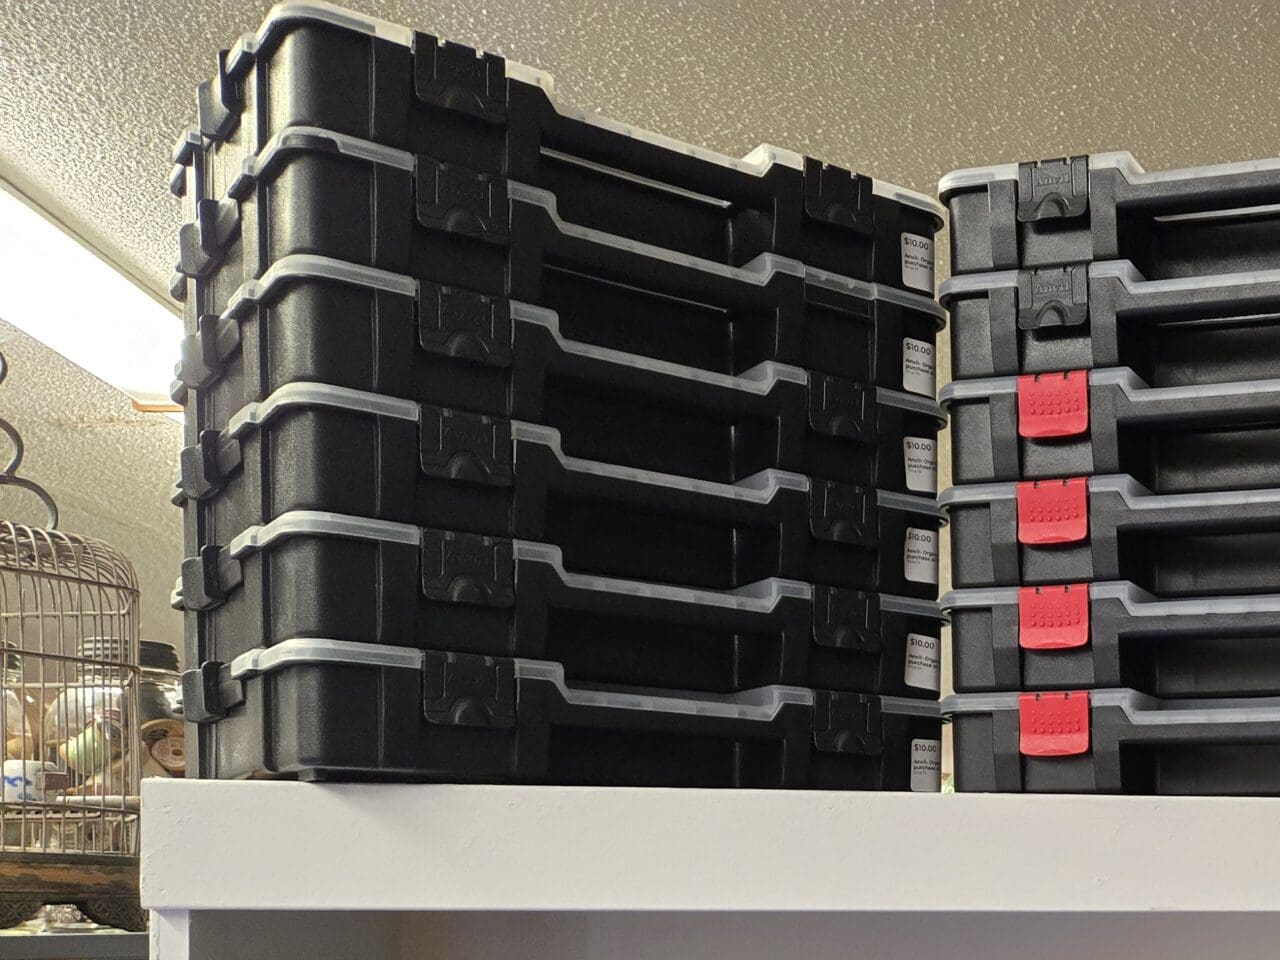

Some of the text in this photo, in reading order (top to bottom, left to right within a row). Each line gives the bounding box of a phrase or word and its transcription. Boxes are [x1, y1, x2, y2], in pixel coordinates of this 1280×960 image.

[1035, 173, 1071, 187] Anvil
[904, 237, 929, 250] $10.00
[1034, 280, 1071, 294] Anvil
[905, 342, 931, 355] $10.00
[907, 441, 932, 452] $10.00
[907, 531, 932, 542] $10.00
[910, 638, 935, 649] $10.00
[914, 743, 937, 752] $10.00
